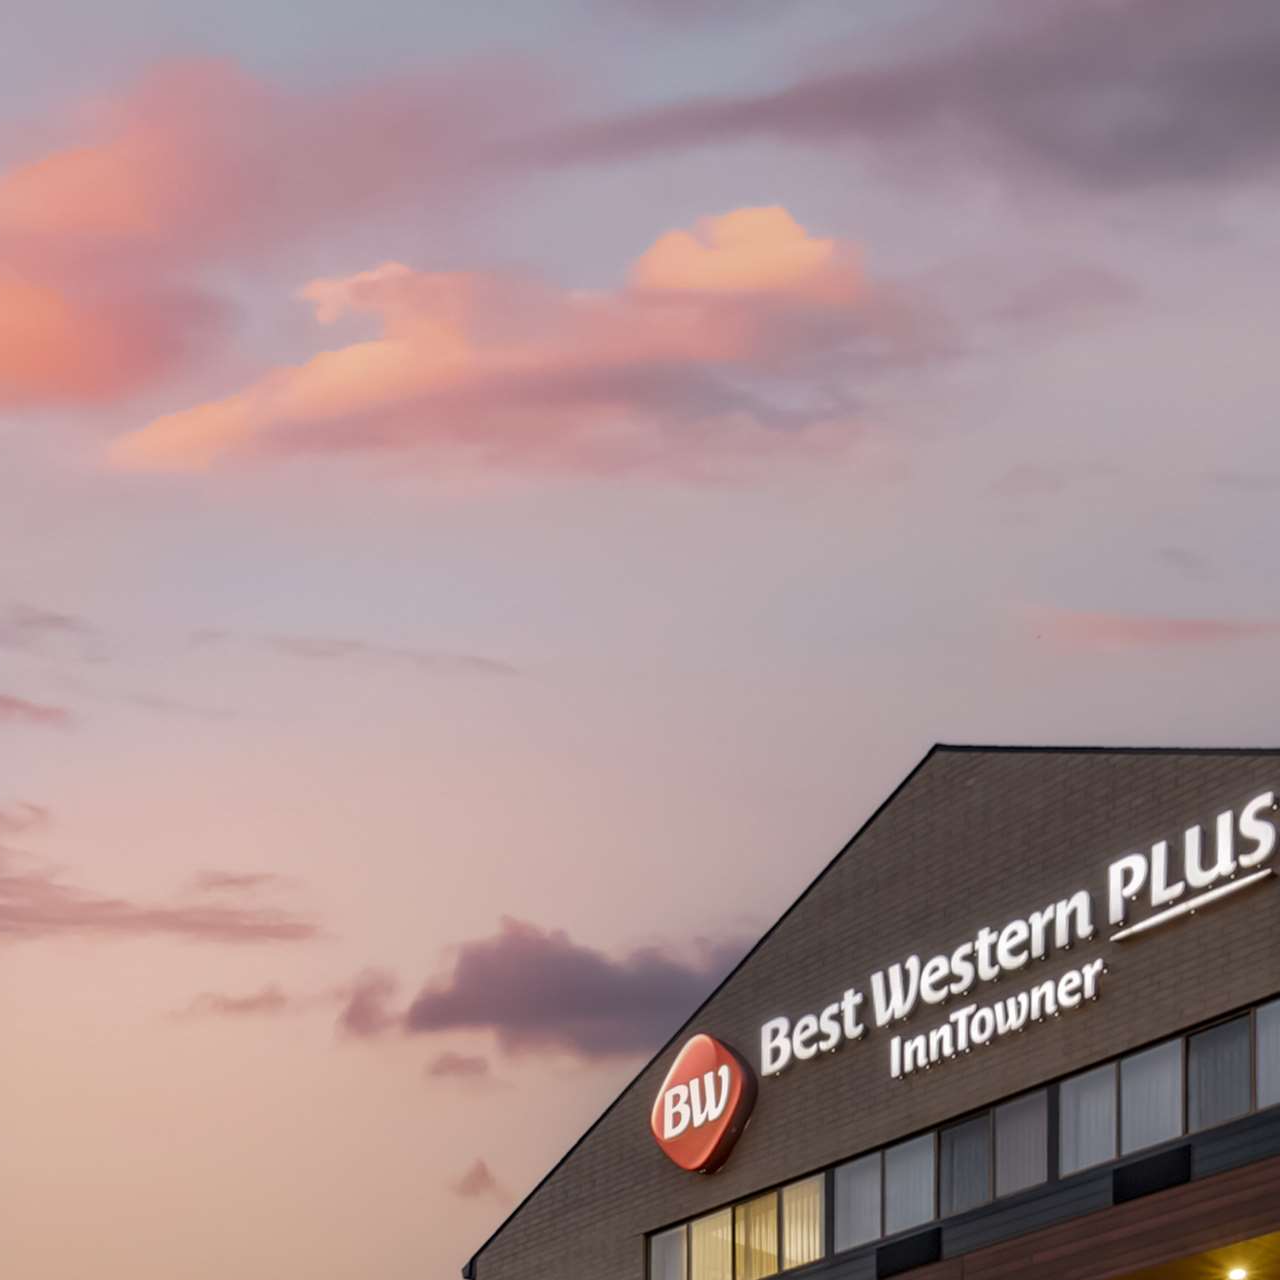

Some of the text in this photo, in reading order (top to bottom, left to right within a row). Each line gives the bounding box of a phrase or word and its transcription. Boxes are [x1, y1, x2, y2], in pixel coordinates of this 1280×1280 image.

[760, 791, 1279, 1077] Best Western PLUS
[890, 957, 1105, 1079] InnTowner
[663, 1063, 732, 1140] BW
